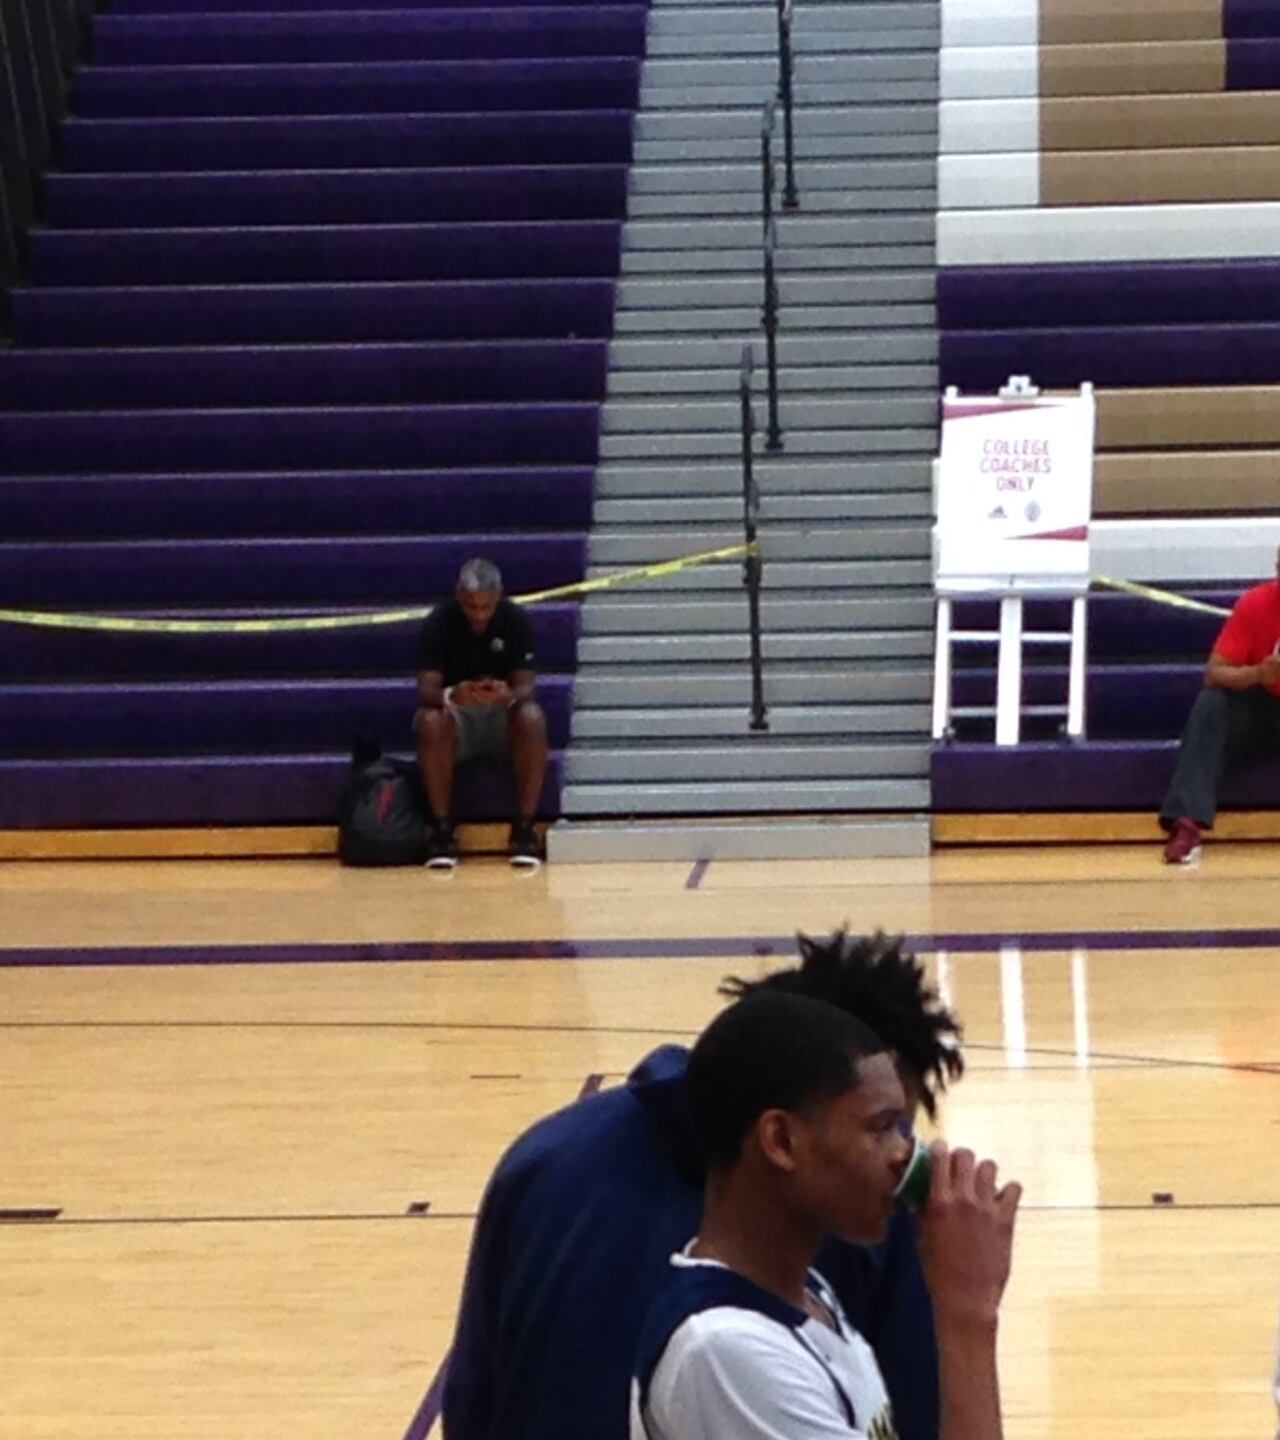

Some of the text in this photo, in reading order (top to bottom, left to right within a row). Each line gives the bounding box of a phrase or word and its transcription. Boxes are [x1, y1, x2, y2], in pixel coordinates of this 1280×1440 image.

[982, 438, 1051, 456] COLLEGE
[980, 457, 1052, 474] COACHES
[996, 476, 1035, 492] ONLY
